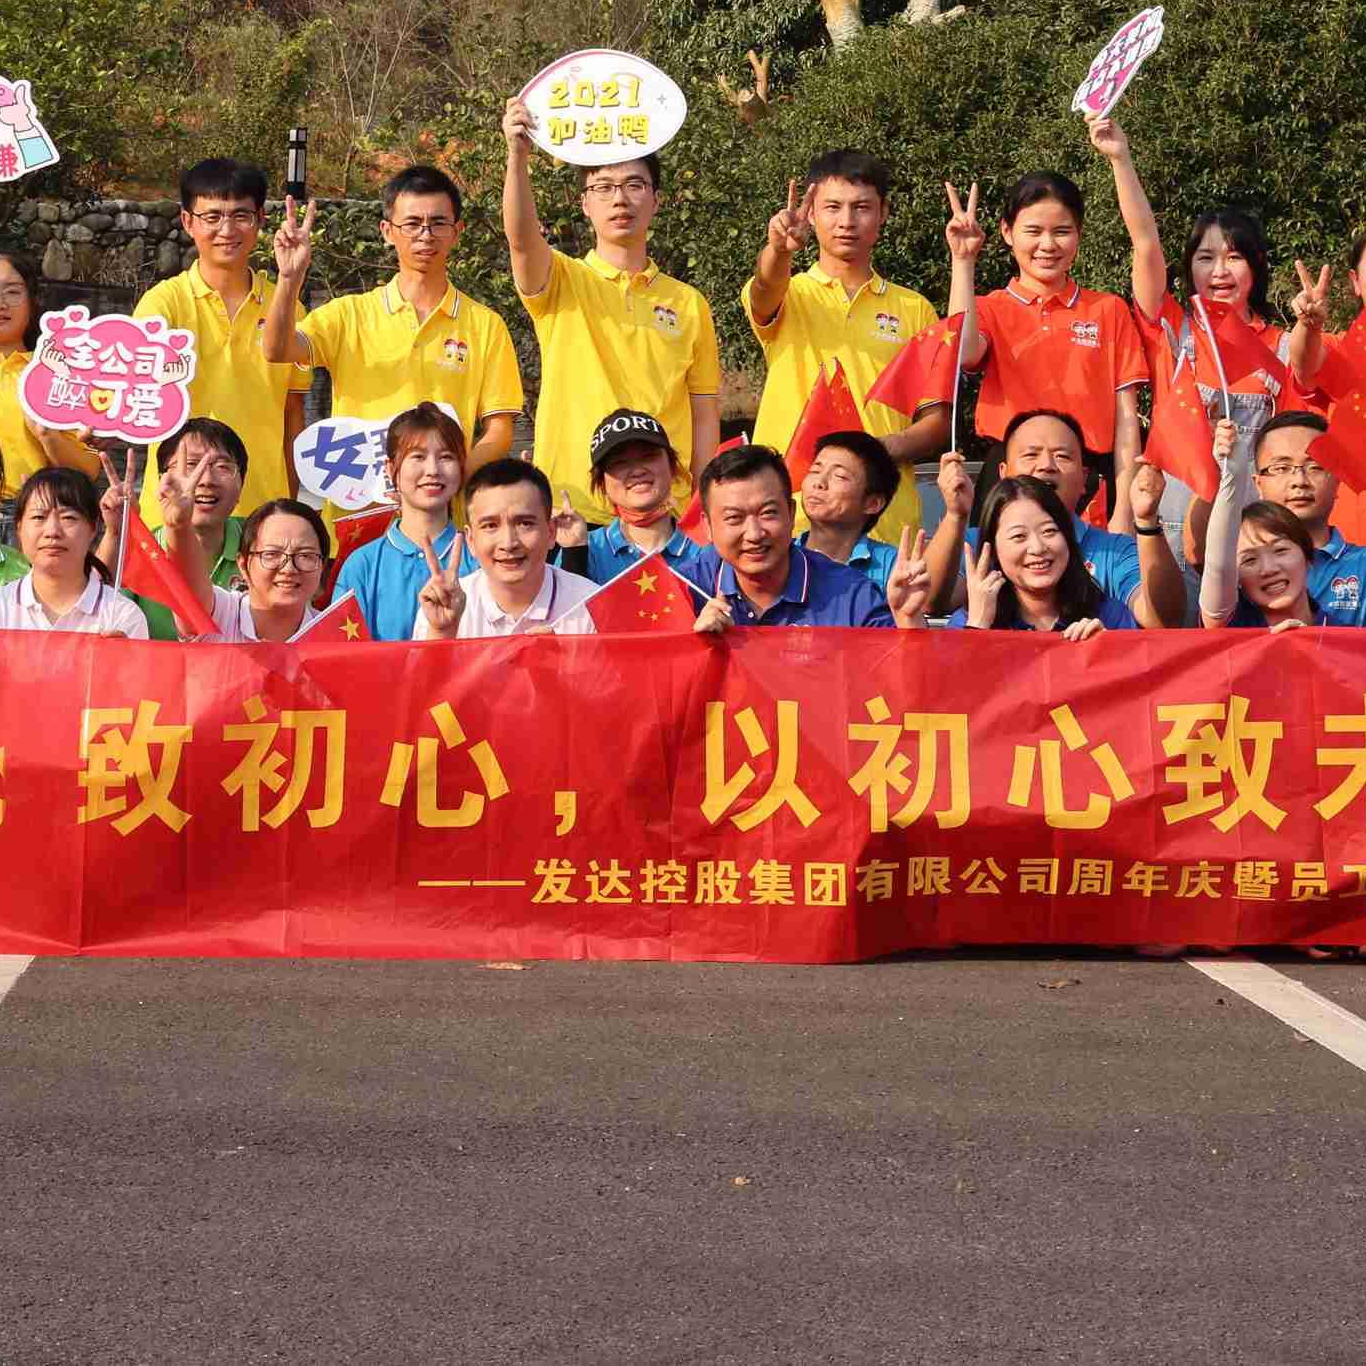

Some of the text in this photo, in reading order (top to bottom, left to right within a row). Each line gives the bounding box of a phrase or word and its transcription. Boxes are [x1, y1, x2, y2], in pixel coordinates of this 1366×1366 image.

[547, 79, 642, 109] 2021
[547, 114, 651, 146] 加油鸭
[64, 333, 165, 377] 全公司
[46, 375, 164, 428] 醉可爱
[590, 414, 660, 452] SPORT
